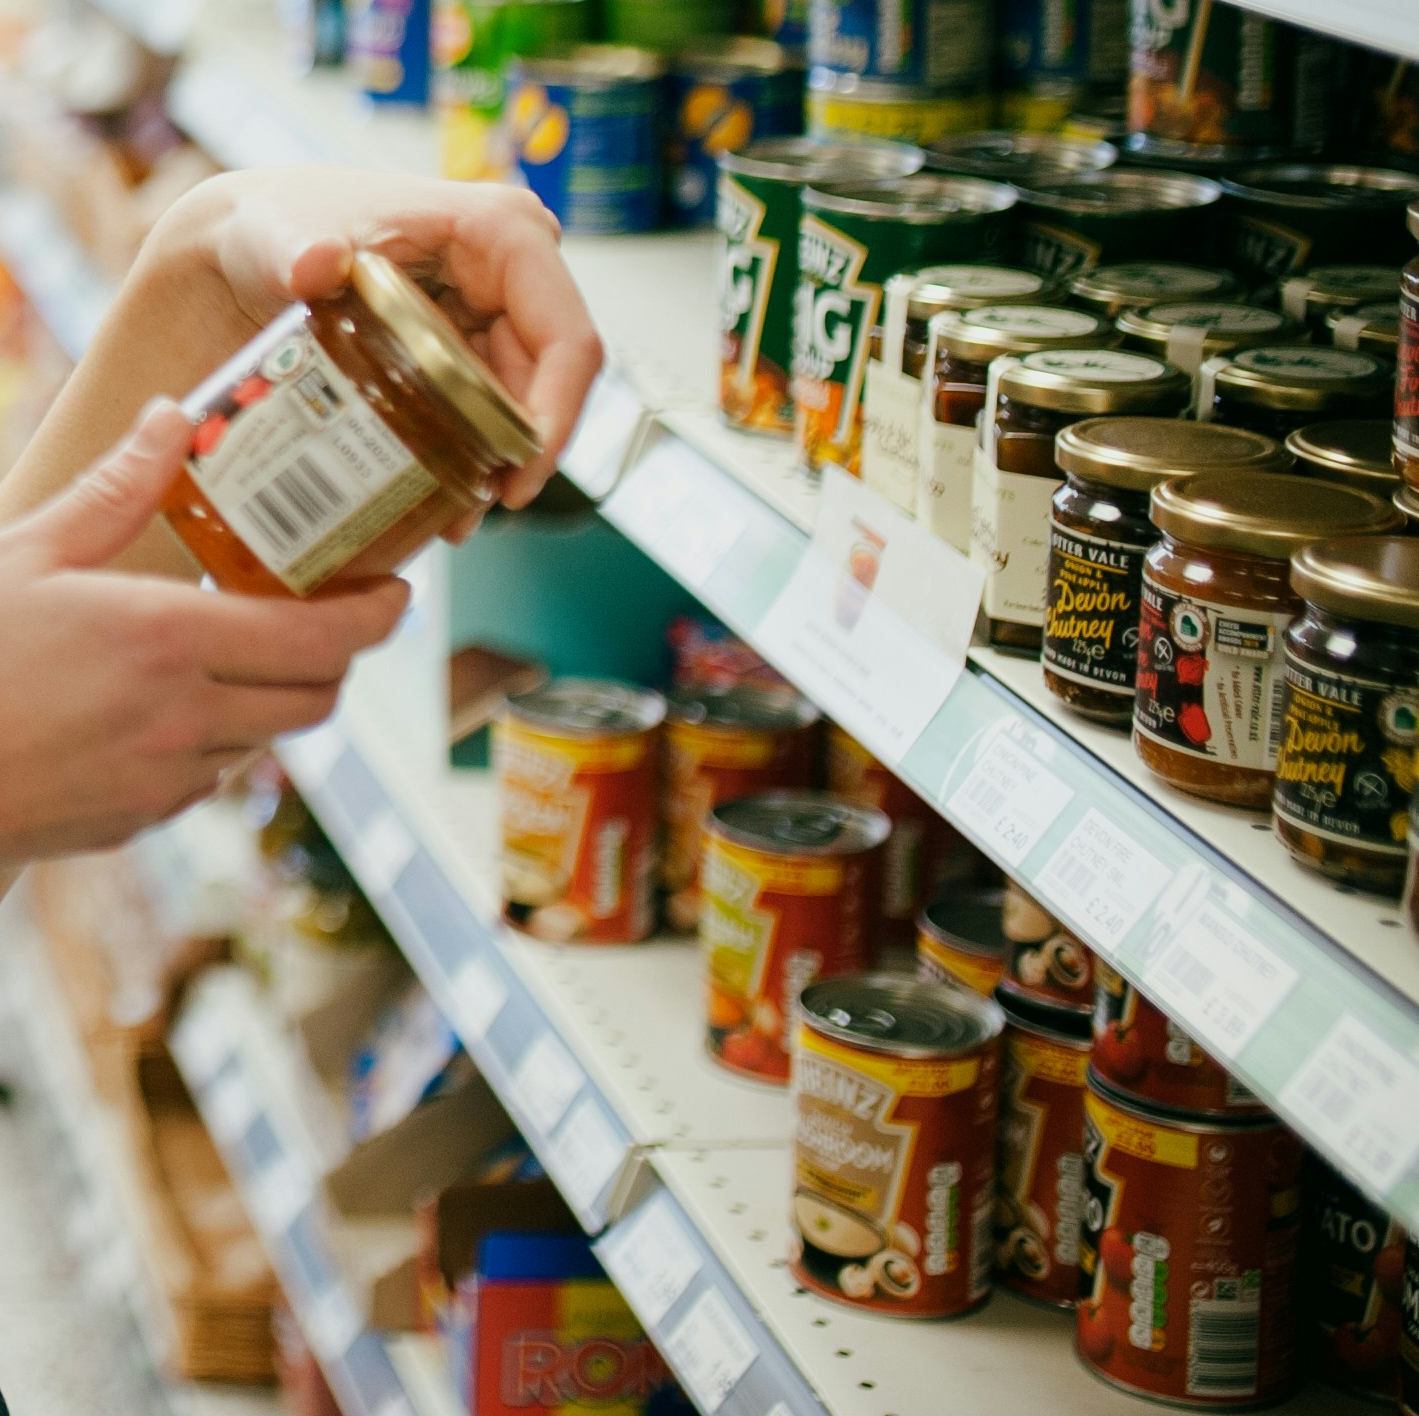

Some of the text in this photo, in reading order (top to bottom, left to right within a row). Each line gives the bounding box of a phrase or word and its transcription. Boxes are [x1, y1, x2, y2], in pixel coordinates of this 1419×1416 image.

[1088, 548, 1129, 569] VALE
[1054, 578, 1132, 614] Devon
[1046, 605, 1115, 650] Chutney
[1093, 665, 1128, 682] DEVON
[1318, 680, 1363, 706] VALE
[1285, 714, 1366, 755] Devon
[993, 813, 1009, 832] £
[1081, 817, 1135, 866] DEVON FIRE
[1067, 833, 1111, 874] CHUTNEY
[1084, 894, 1128, 938] £ 2.40
